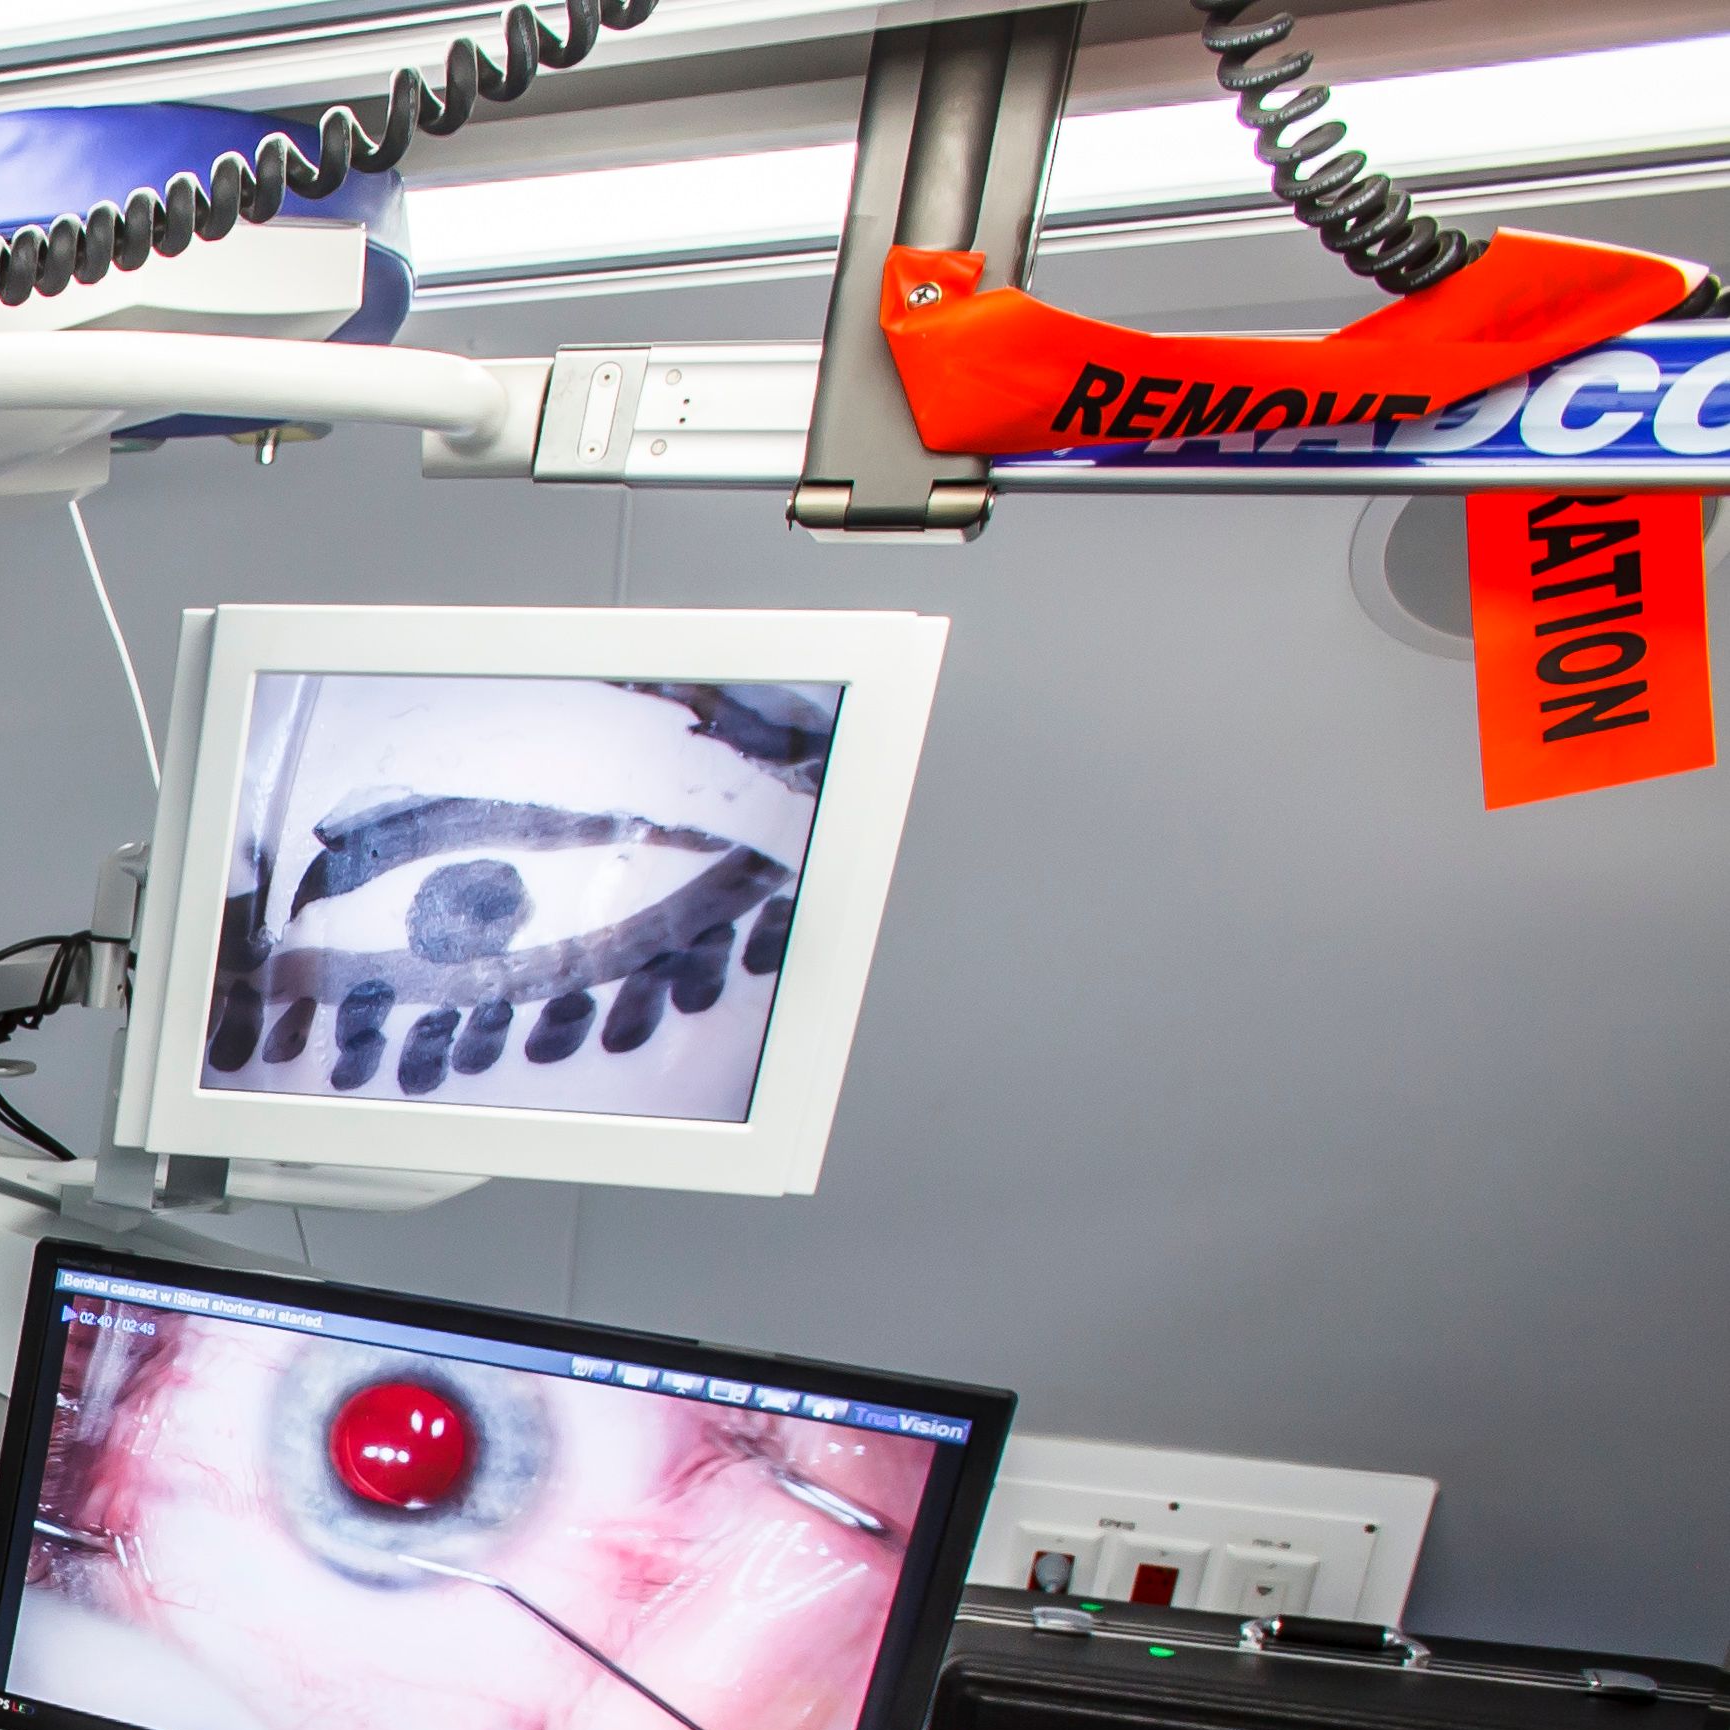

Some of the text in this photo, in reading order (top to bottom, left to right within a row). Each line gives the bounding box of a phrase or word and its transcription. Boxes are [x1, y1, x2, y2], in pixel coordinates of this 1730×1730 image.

[1145, 350, 1730, 454] DCO
[79, 1312, 112, 1328] 02:40
[122, 1318, 156, 1337] 02:45
[110, 1282, 157, 1301] cataract
[160, 1293, 172, 1304] w
[278, 1310, 325, 1330] started.
